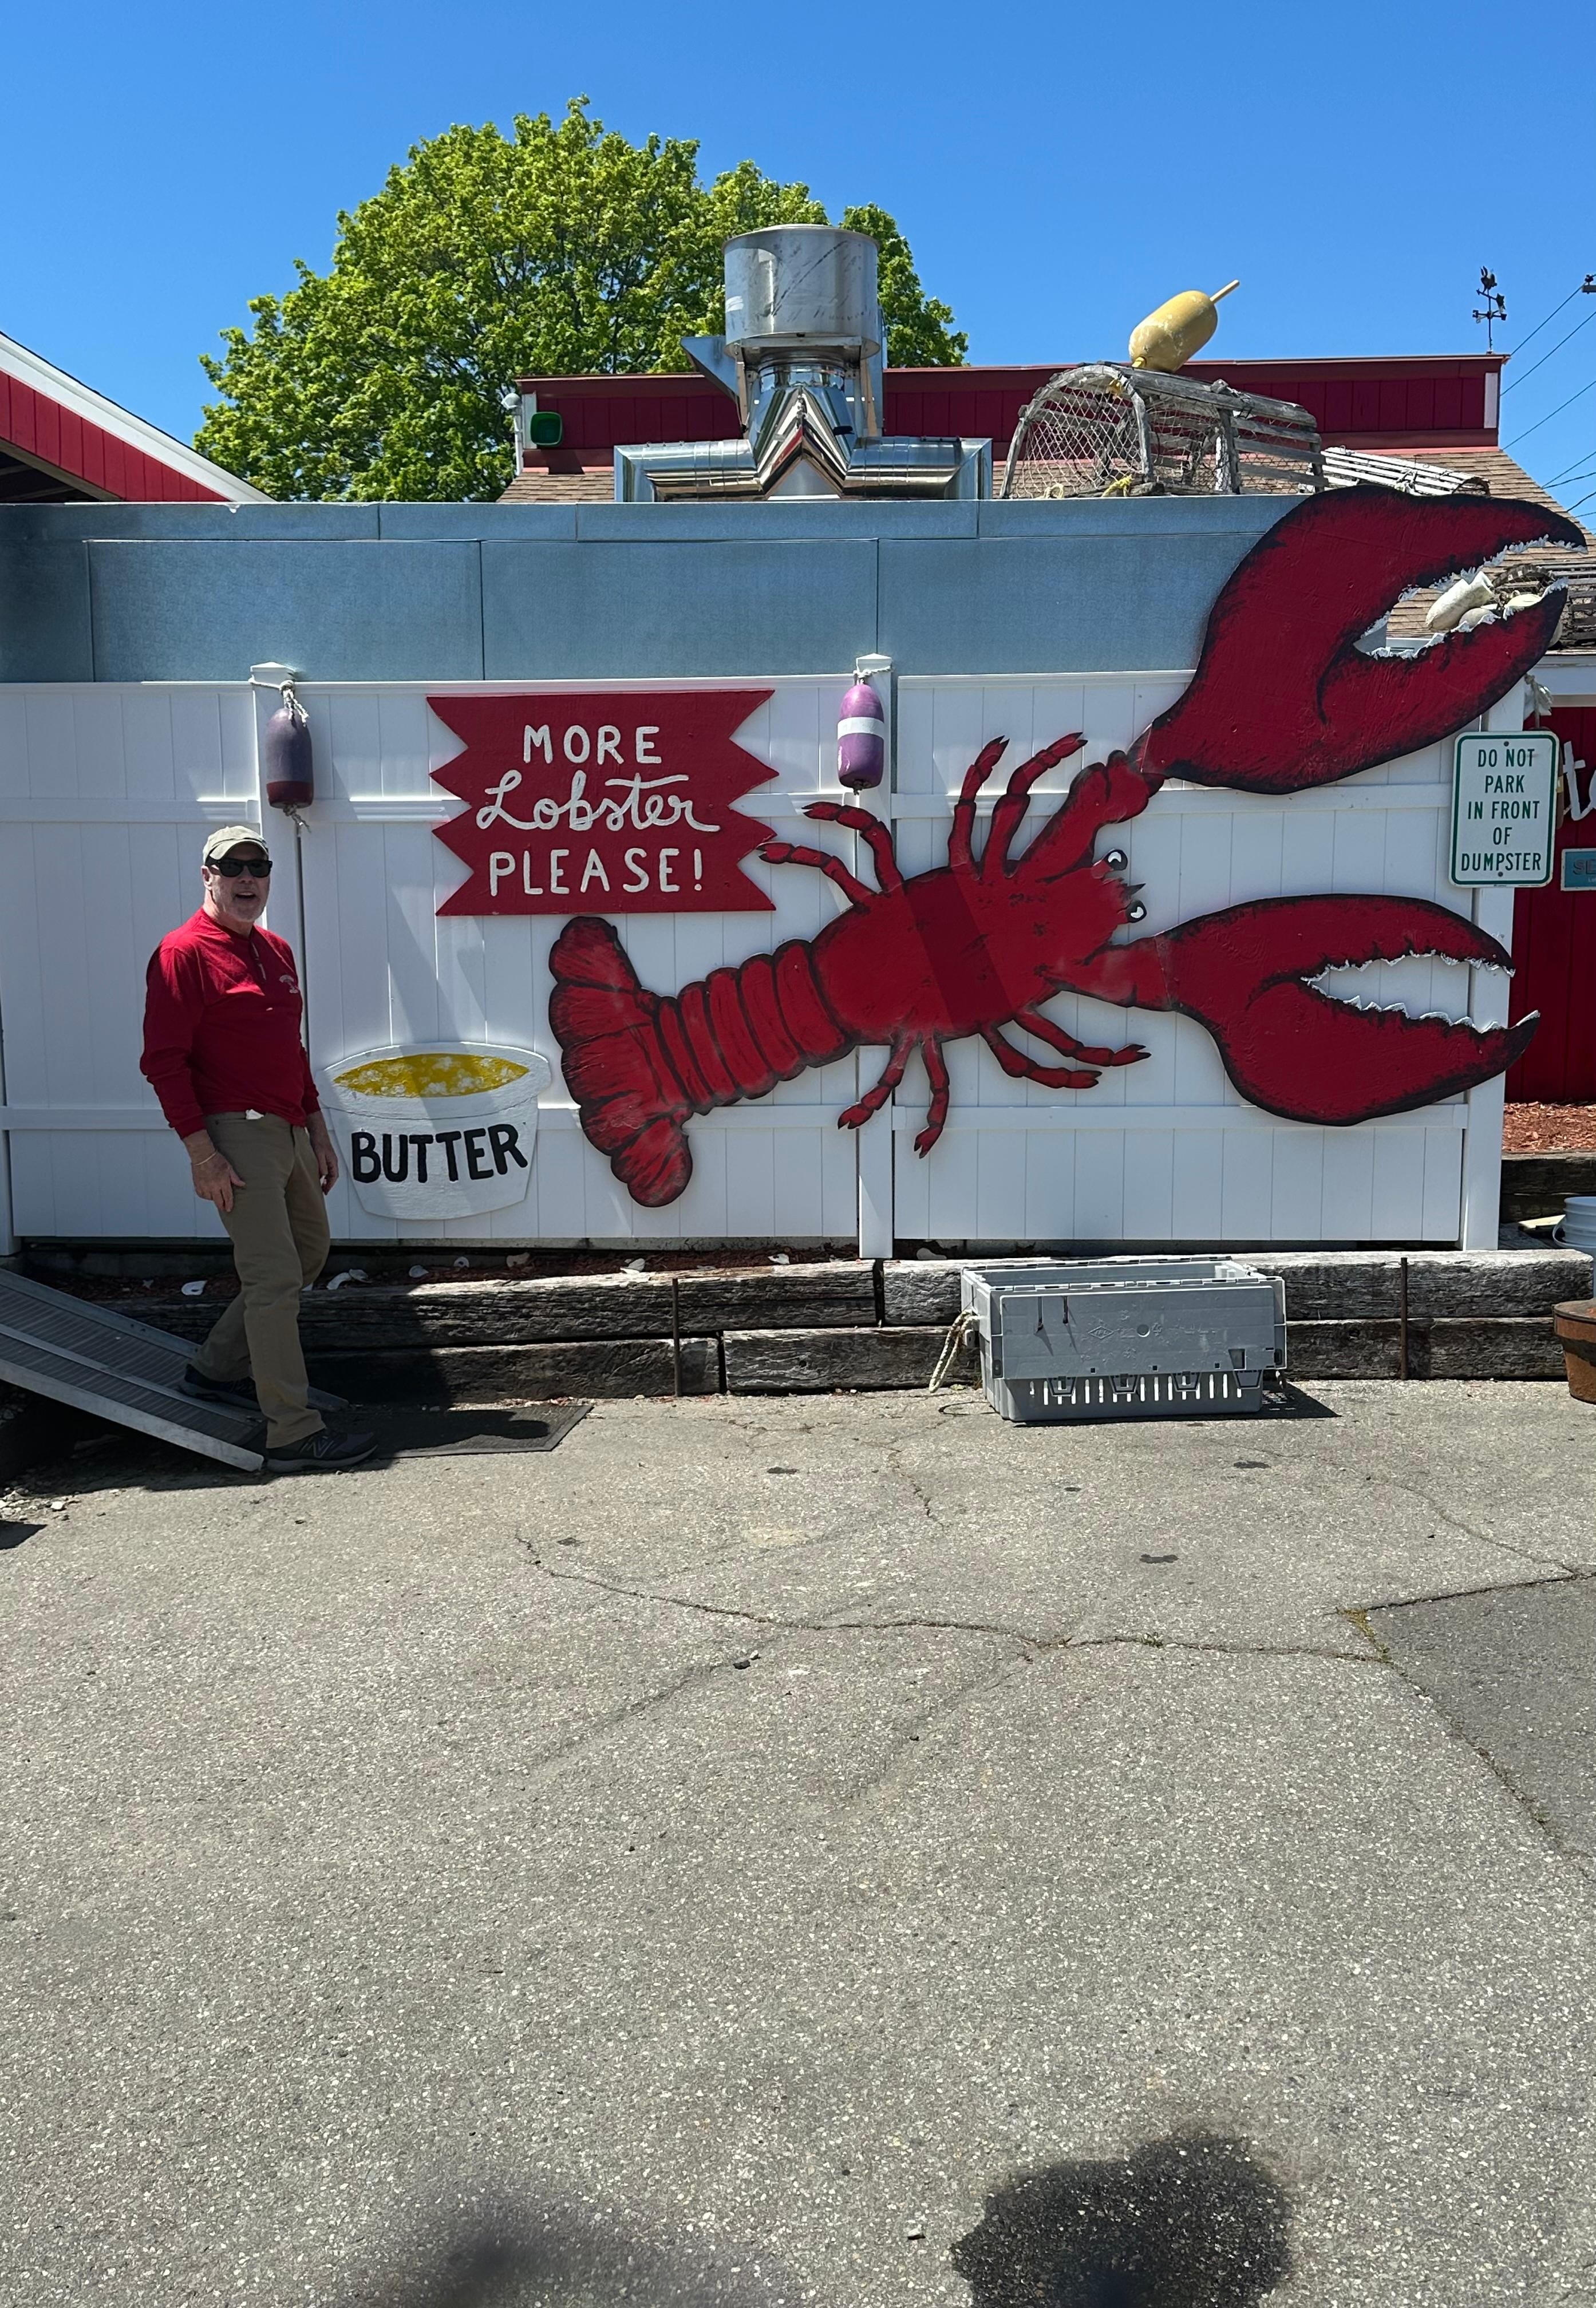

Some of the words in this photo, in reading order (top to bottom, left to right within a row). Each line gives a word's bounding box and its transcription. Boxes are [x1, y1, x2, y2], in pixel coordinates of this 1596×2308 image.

[523, 724, 662, 765] MORE
[1478, 749, 1498, 768] DO
[1505, 749, 1535, 767] NOT
[1484, 775, 1524, 793] PARK
[476, 769, 721, 832] Lobster
[1467, 801, 1483, 819] IN
[1491, 800, 1540, 819] FRONT
[1493, 827, 1512, 845] OF
[1461, 853, 1542, 871] DUMPSTER
[489, 848, 703, 897] PLEASE!
[351, 1124, 528, 1184] BUTTER
